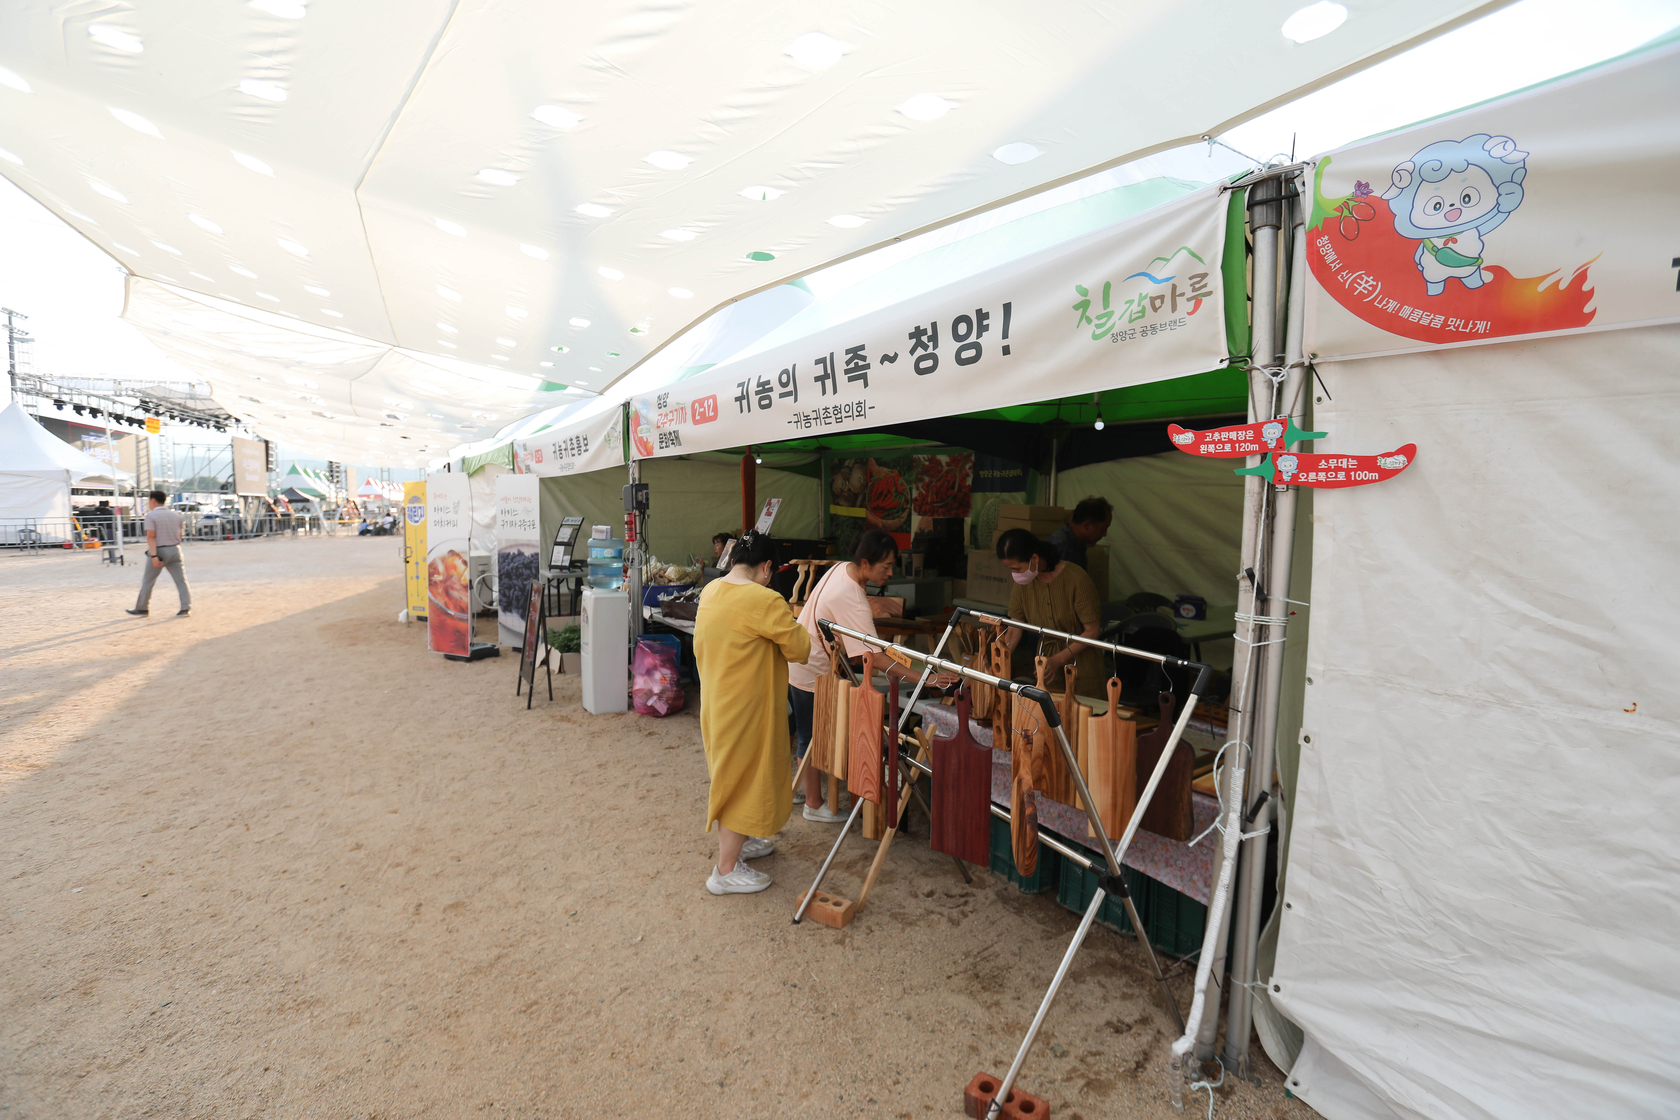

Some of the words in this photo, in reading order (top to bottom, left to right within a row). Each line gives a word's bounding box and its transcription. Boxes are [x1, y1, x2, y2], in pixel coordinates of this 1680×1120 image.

[1316, 235, 1343, 272] 청양에서
[1398, 305, 1446, 329] 매콤달콤
[1445, 317, 1491, 334] 맛나게!
[1072, 272, 1214, 341] 칠갑마루
[1110, 328, 1137, 344] 청양군
[1139, 317, 1187, 338] 공동브랜드
[734, 363, 799, 414] 귀농의
[656, 391, 670, 410] 청양
[694, 398, 715, 420] 2-12
[656, 405, 687, 429] 고추구기자
[658, 429, 682, 450] 문화축제
[1204, 430, 1255, 442] 고추판매장은
[552, 434, 589, 460] 귀농귀촌홍보
[1199, 443, 1232, 454] 왼쪽으로
[1234, 442, 1259, 452] 120m
[1318, 458, 1358, 469] 소무대는
[1298, 471, 1347, 482] 오른쪽으로
[1349, 470, 1379, 481] 100m
[433, 505, 451, 514] 아이스
[500, 508, 519, 517] 아이스
